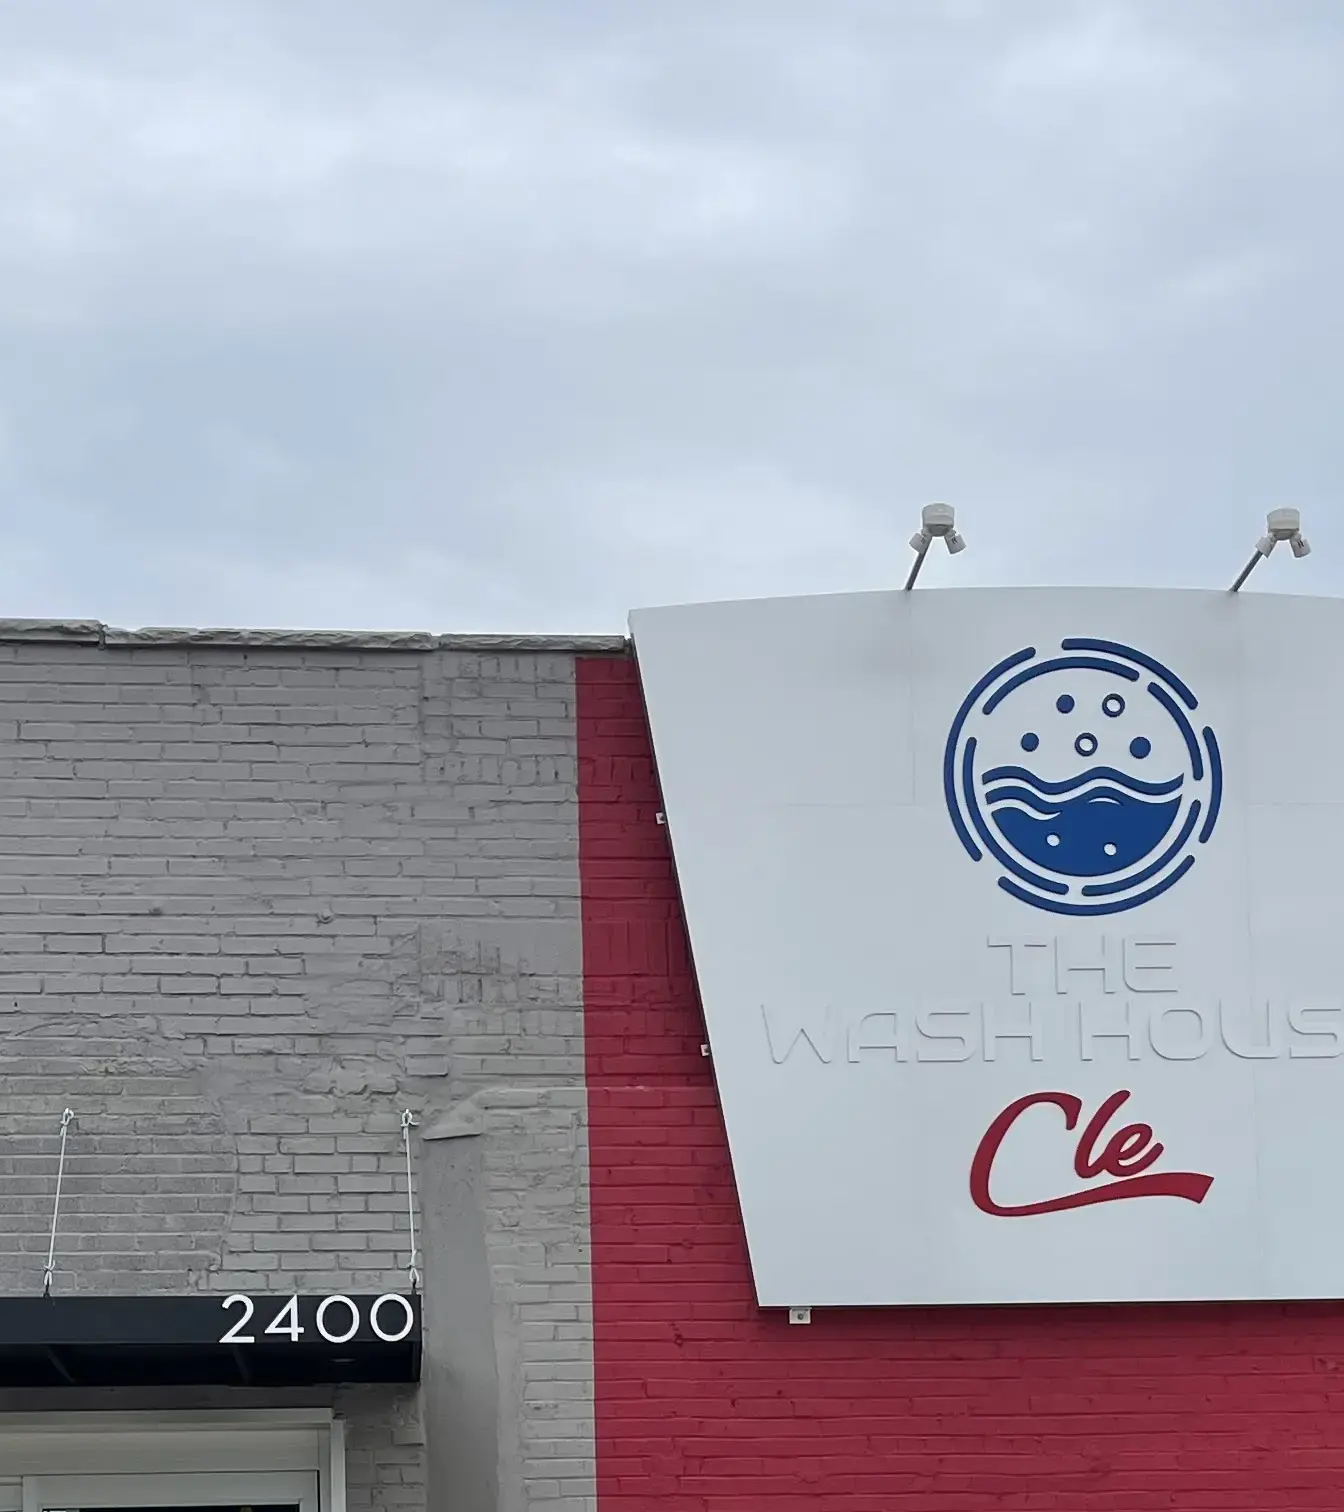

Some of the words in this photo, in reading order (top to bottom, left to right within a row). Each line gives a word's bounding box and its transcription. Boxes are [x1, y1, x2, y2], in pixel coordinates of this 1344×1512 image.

[986, 934, 1178, 997] THE
[760, 1001, 1045, 1065] WASH
[969, 1089, 1215, 1218] Cle
[218, 1293, 414, 1344] 2400
